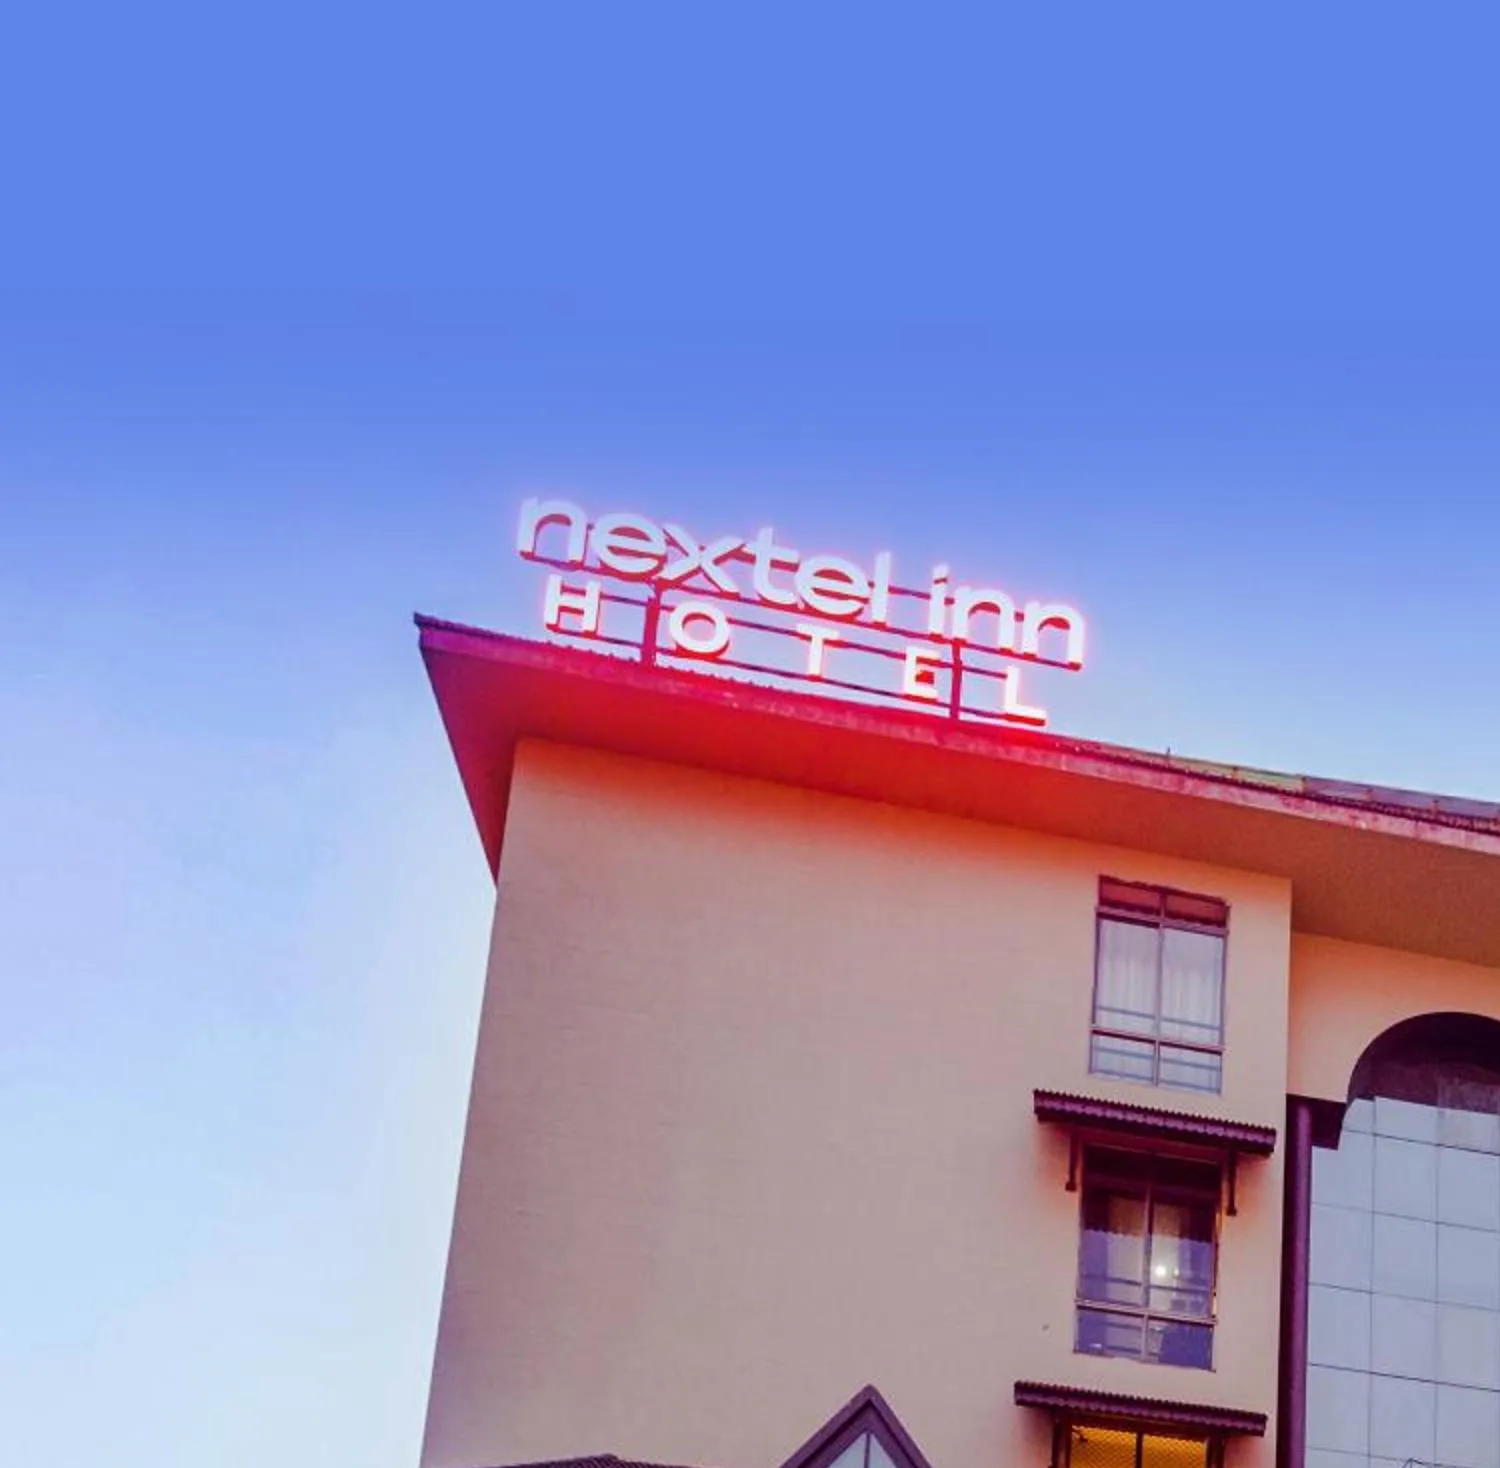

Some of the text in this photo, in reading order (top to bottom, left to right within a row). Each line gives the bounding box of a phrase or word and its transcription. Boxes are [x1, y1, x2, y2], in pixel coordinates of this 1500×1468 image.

[517, 497, 1086, 664] nextel inn
[544, 574, 1047, 719] HOTEL
